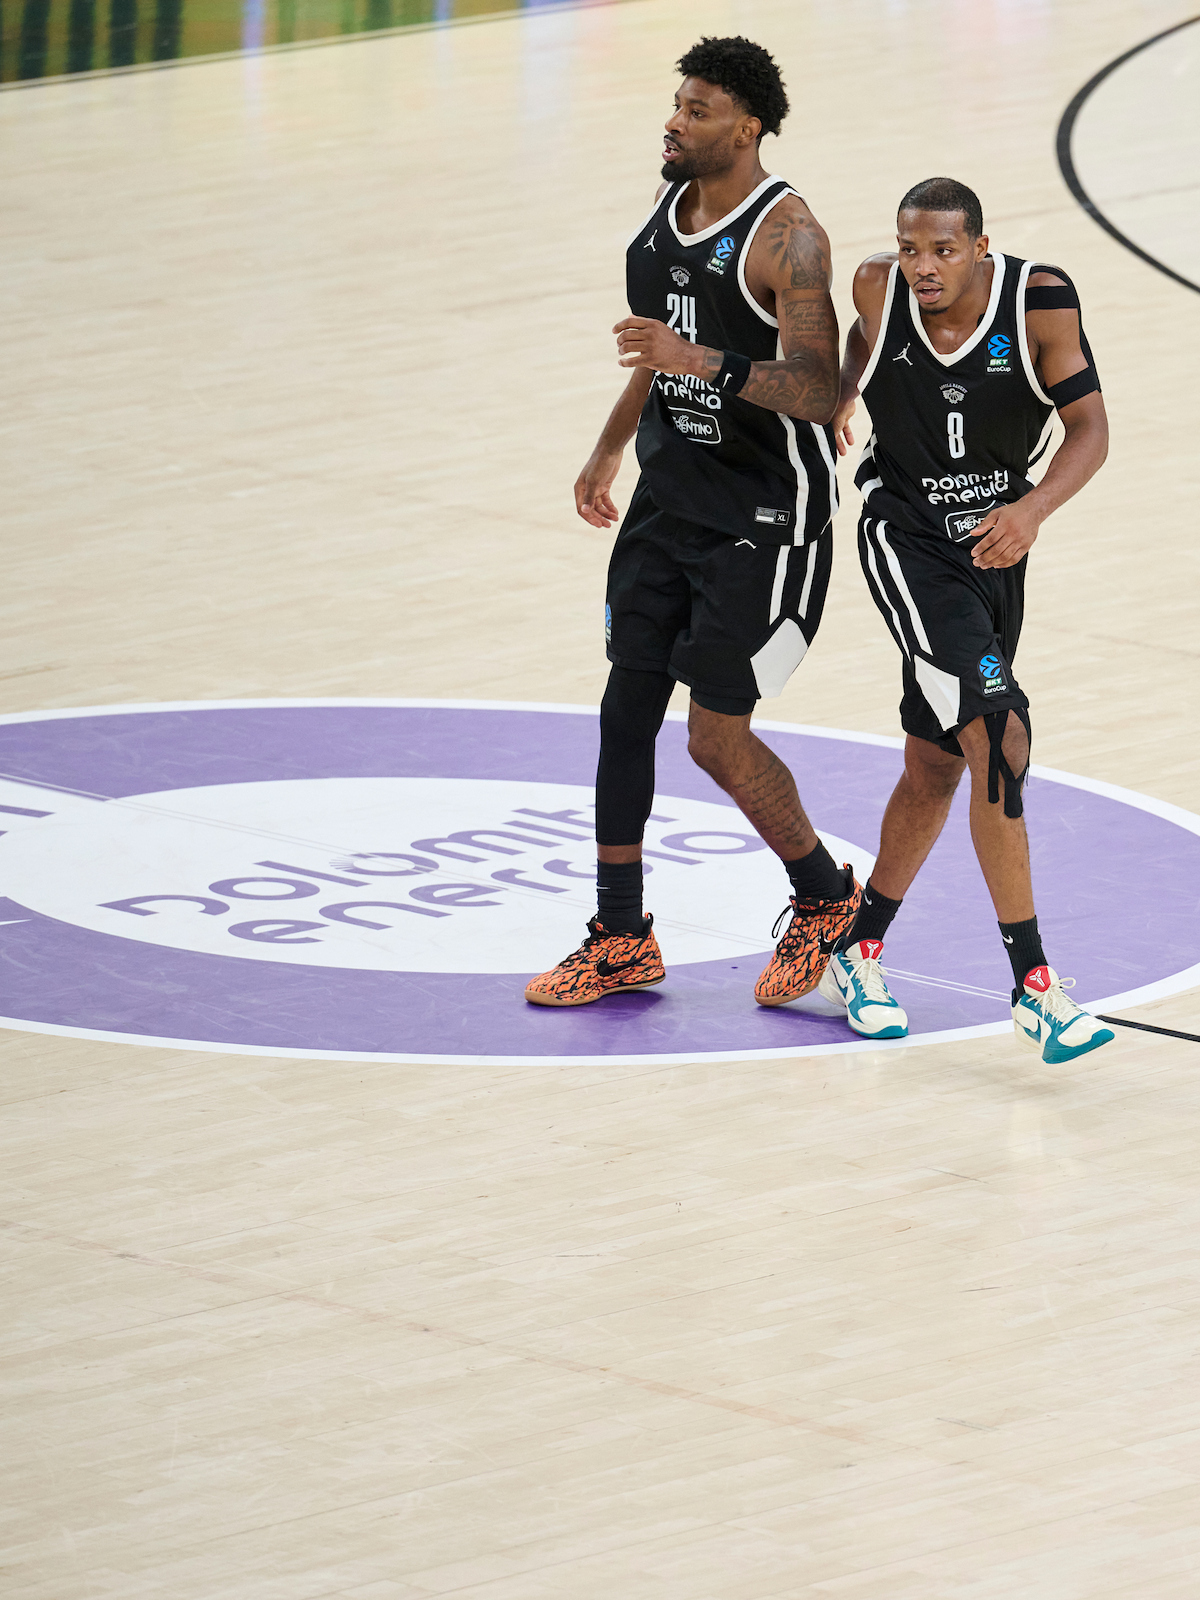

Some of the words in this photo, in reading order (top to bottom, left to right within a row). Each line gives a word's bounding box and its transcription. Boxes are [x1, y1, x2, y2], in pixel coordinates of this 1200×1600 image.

[666, 292, 698, 345] 24
[989, 358, 1008, 366] BKT
[947, 411, 966, 459] 8
[777, 513, 787, 522] XL
[985, 677, 1002, 688] BKT
[983, 685, 1007, 694] EuroCup
